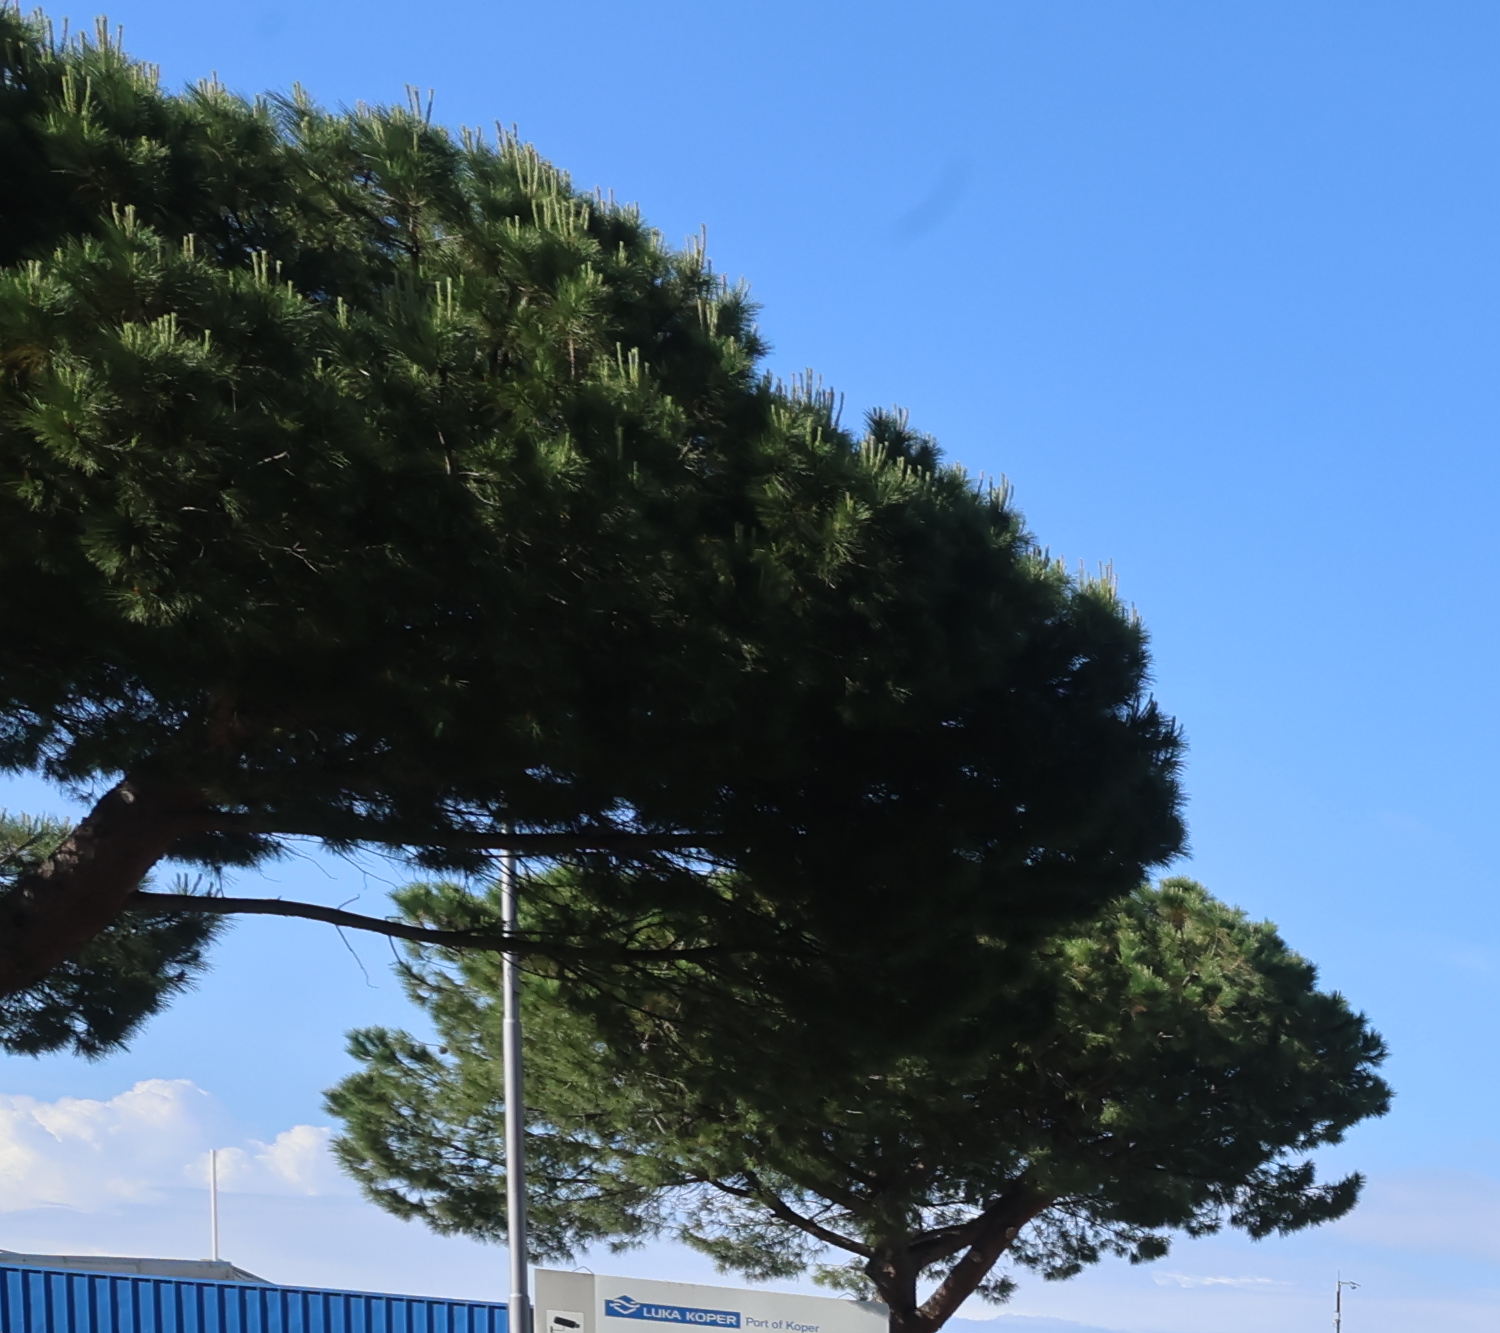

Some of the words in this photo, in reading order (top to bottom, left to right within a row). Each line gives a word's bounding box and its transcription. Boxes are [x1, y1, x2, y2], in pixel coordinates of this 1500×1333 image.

[643, 1307, 681, 1320] LUKA
[686, 1312, 736, 1325] KOPER
[745, 1317, 768, 1328] Port
[772, 1320, 782, 1329] of
[786, 1321, 819, 1333] Koper
